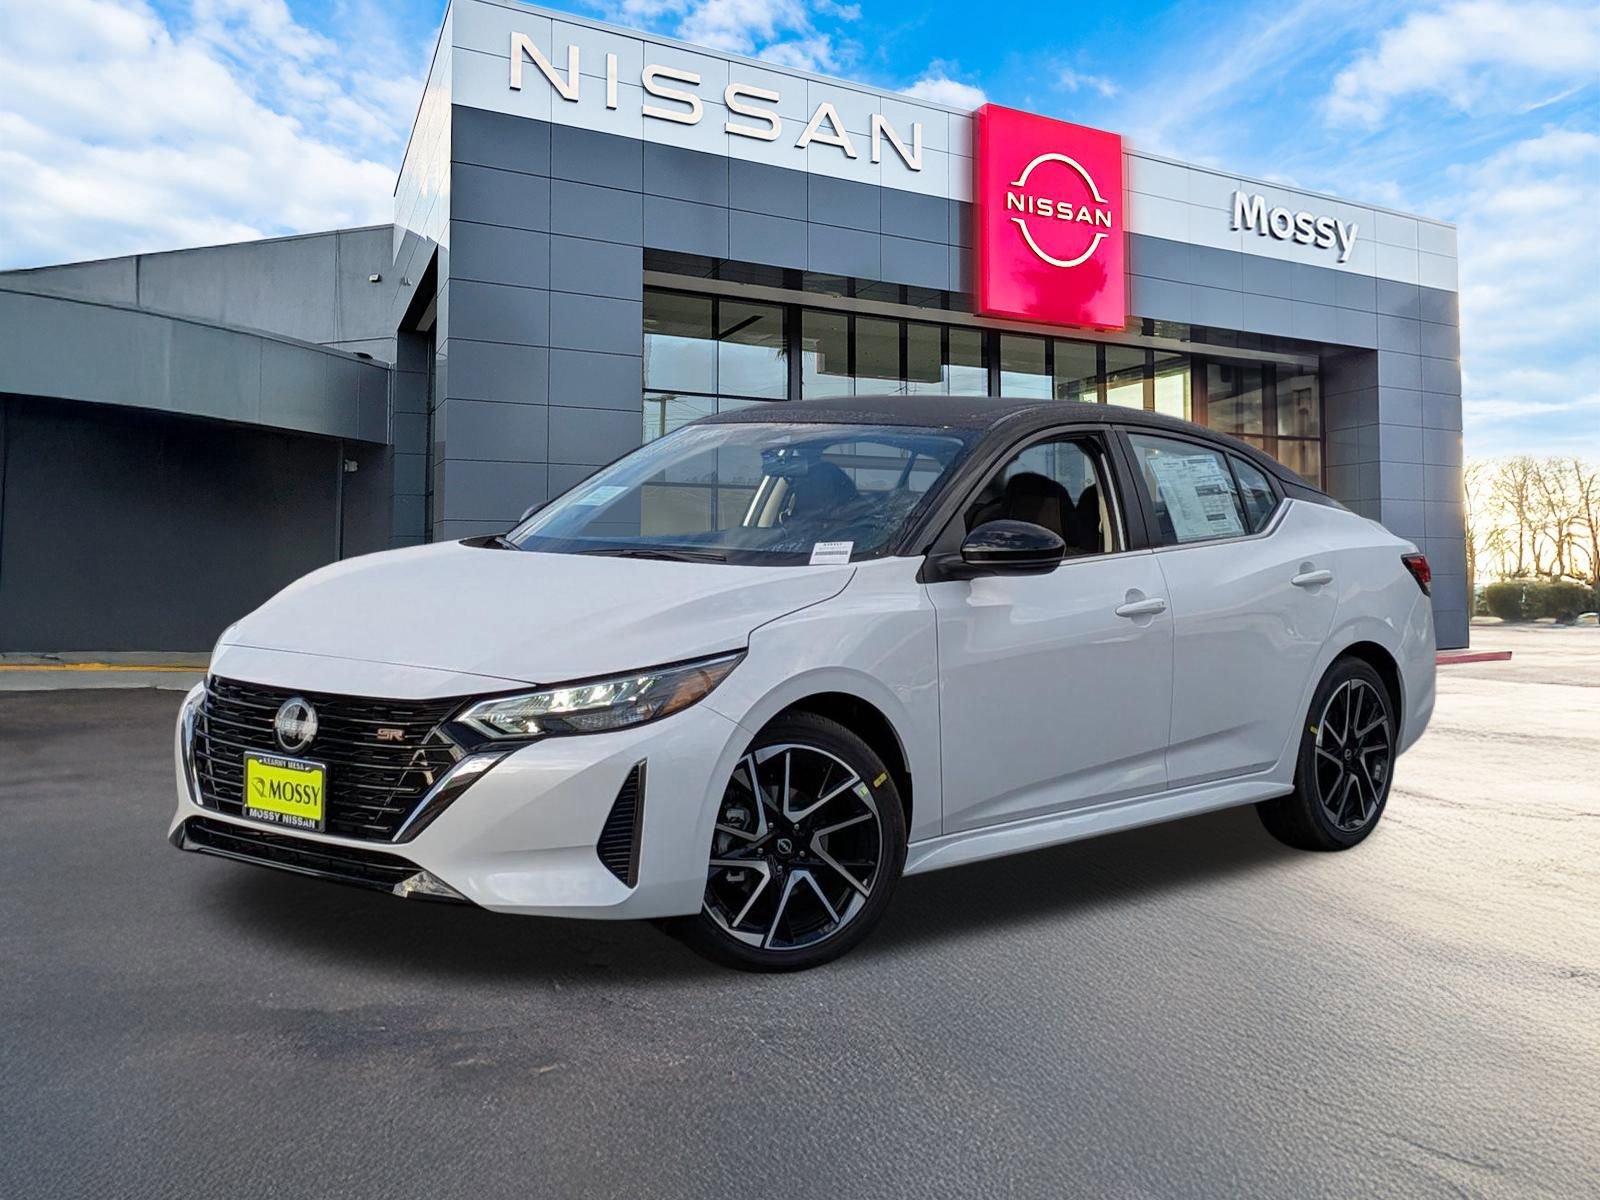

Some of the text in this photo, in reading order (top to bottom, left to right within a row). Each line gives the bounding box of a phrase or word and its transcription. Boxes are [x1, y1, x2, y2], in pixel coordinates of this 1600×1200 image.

[509, 31, 923, 171] NISSAN
[1007, 191, 1112, 228] NISSAN
[1231, 190, 1359, 262] Mossy
[377, 728, 404, 740] SR
[269, 779, 320, 806] MOSSY
[249, 808, 315, 828] MOSSY NISSAN
